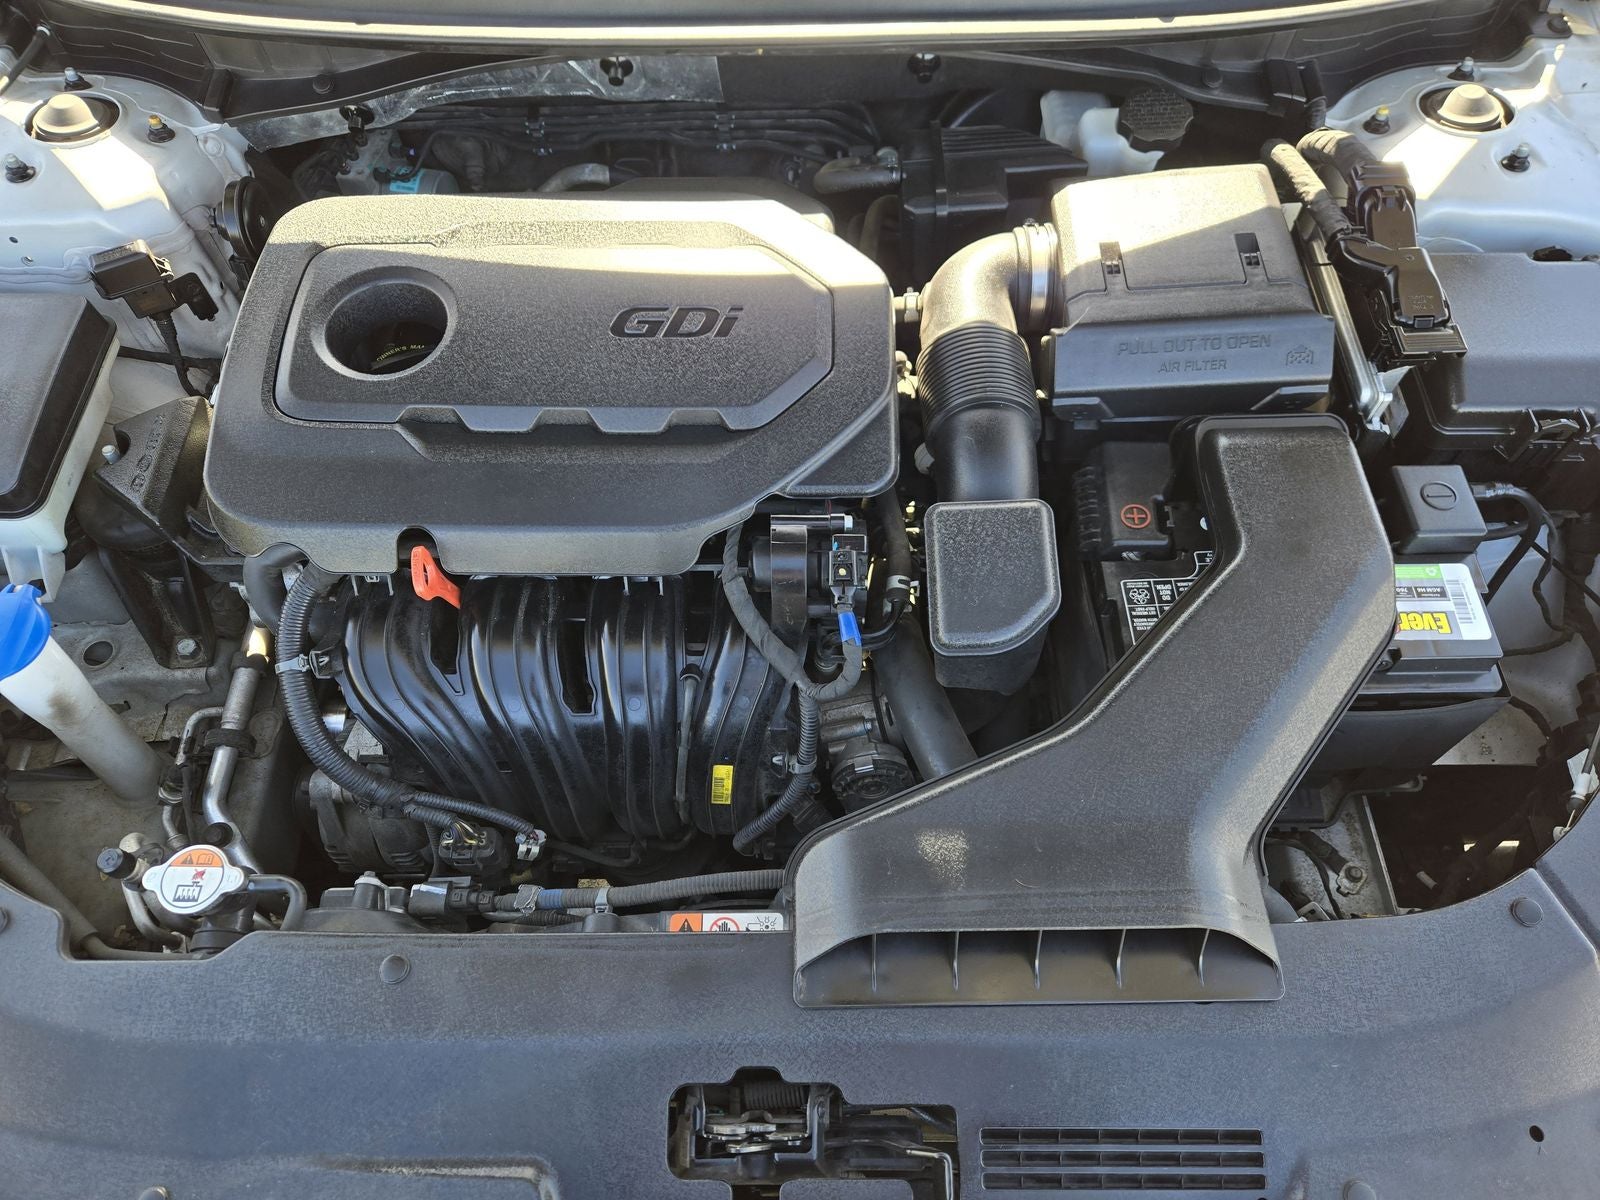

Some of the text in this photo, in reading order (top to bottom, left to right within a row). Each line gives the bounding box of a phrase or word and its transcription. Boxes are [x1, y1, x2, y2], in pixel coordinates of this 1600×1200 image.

[609, 305, 743, 338] GDi
[1117, 334, 1272, 356] PULL OUT TO OPEN
[1158, 358, 1227, 373] AIR FILTER
